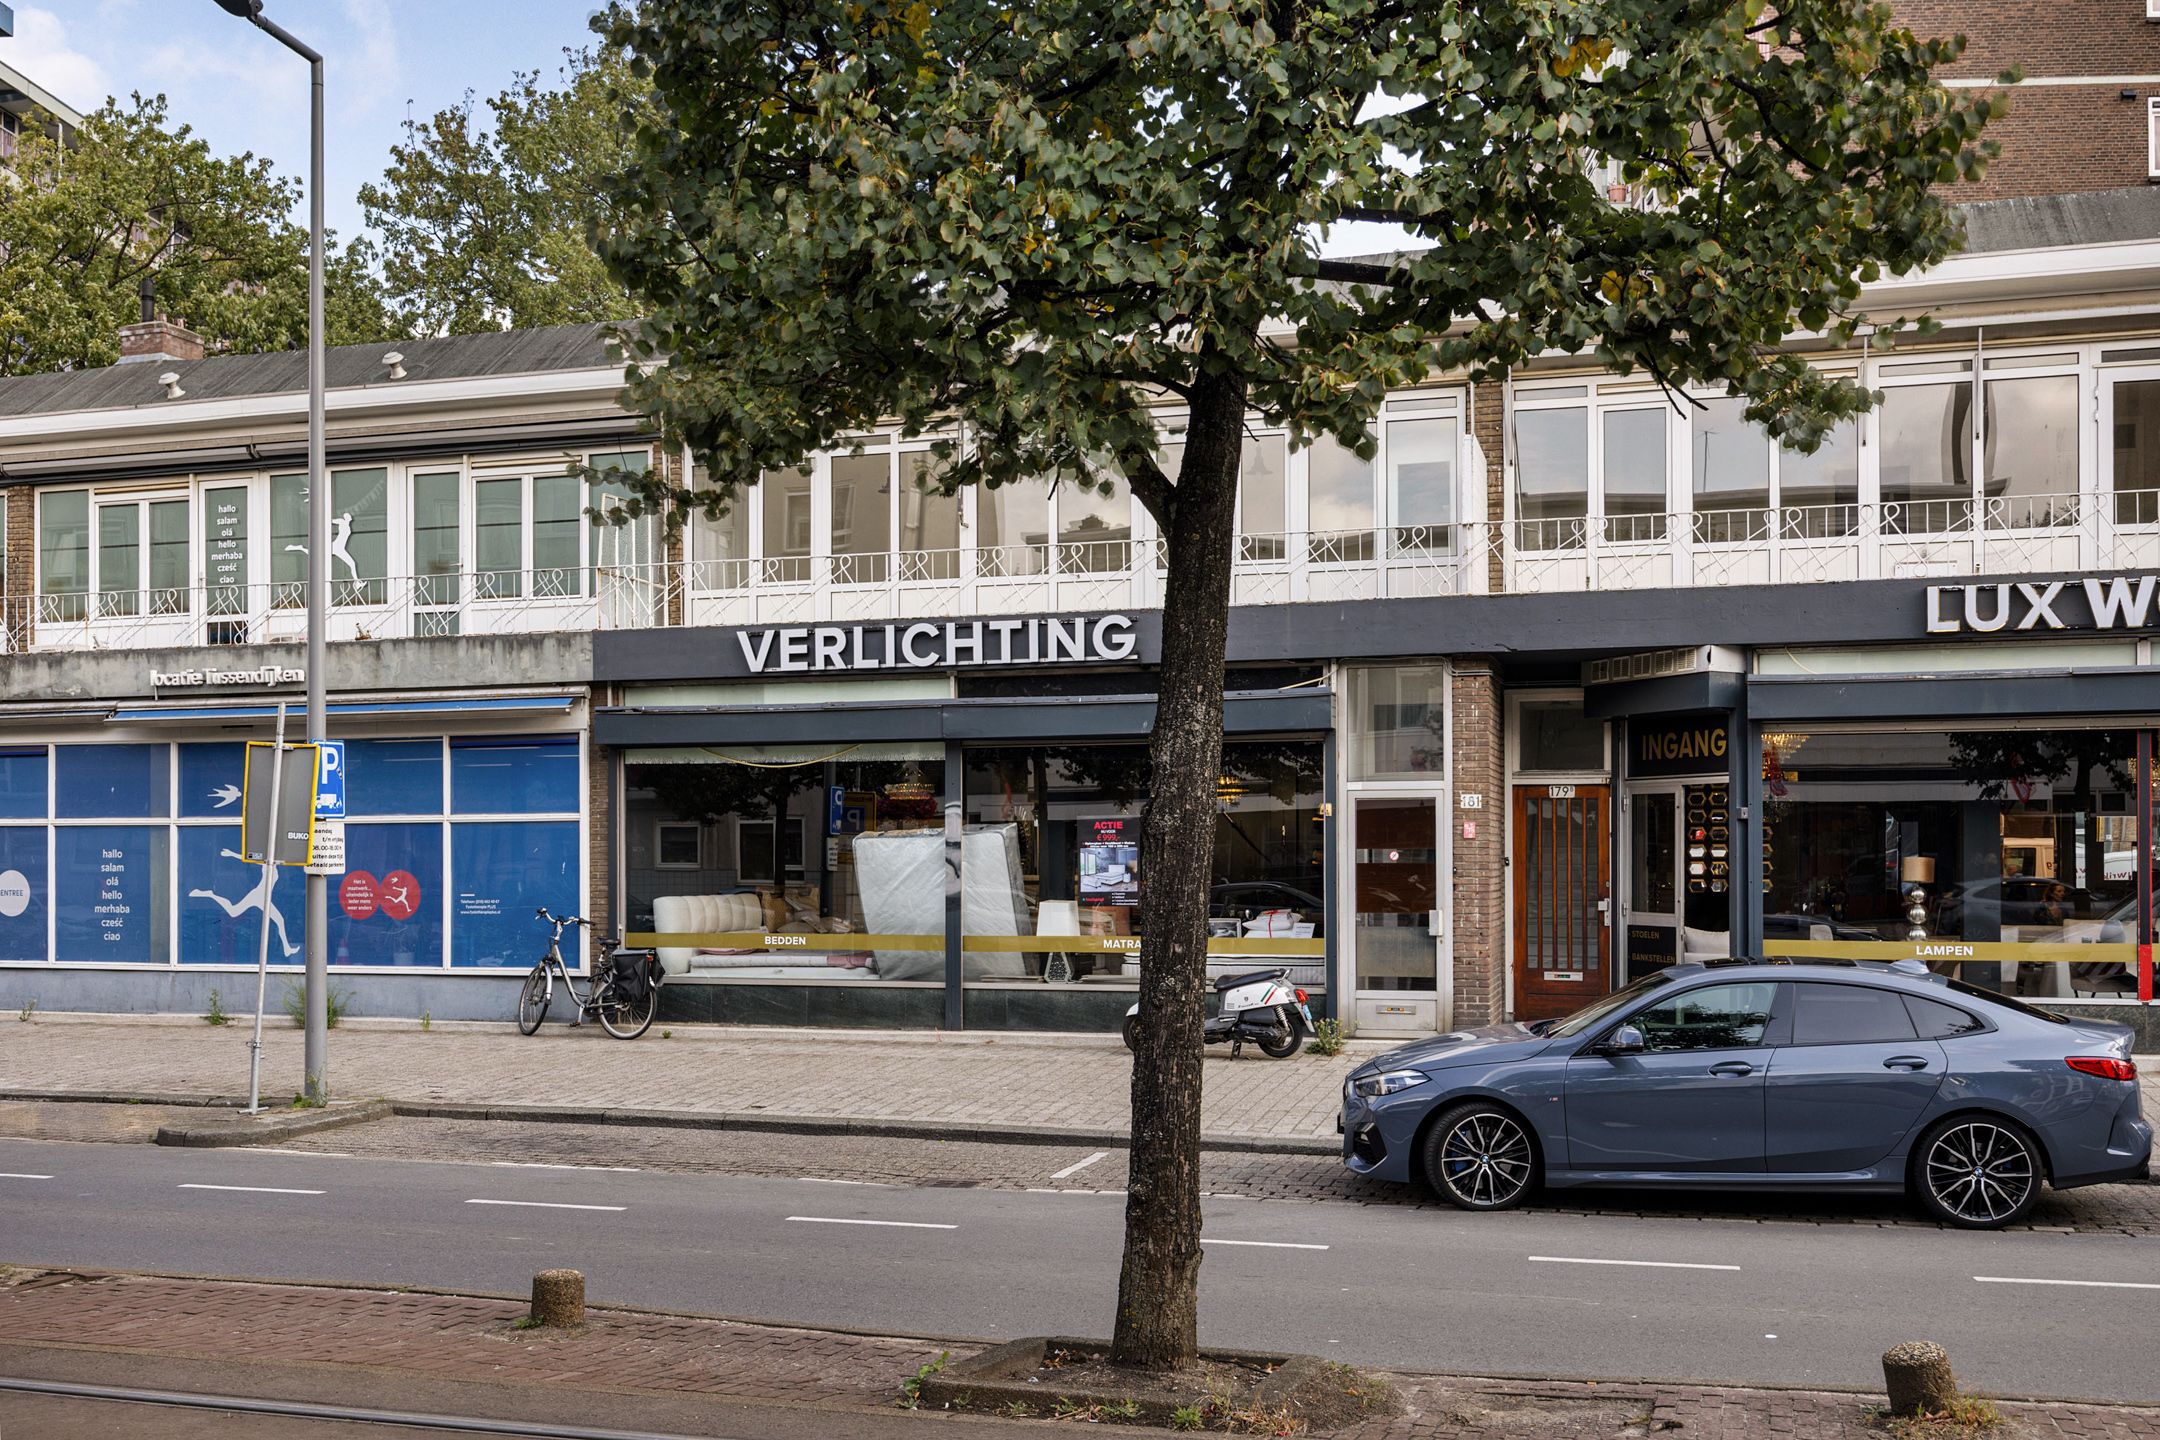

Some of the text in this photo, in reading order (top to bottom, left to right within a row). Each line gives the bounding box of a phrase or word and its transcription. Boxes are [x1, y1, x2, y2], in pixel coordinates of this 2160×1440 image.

[218, 504, 236, 512] hallo
[217, 517, 238, 525] salam
[221, 528, 232, 536] olá
[218, 540, 236, 548] hello
[212, 552, 243, 560] merhaba
[1926, 576, 2160, 632] LUX W
[736, 614, 1136, 672] VERLICHTING
[150, 666, 304, 687] locatie Tussendijken
[1642, 728, 1726, 760] INGANG
[322, 746, 339, 784] P
[1462, 796, 1480, 808] 181
[1094, 821, 1124, 829] ACTIE
[288, 832, 308, 840] BUKO
[102, 849, 122, 858] hallo
[101, 863, 124, 872] salam
[106, 877, 118, 886] olá
[102, 891, 122, 900] hello
[95, 904, 130, 913] merhaba
[101, 918, 123, 927] cześć
[104, 932, 120, 940] ciao
[1632, 930, 1659, 939] STOELEN
[764, 936, 806, 945] BEDDEN
[1916, 945, 1973, 956] LAMPEN
[1632, 953, 1675, 963] BANKSTELLEN
